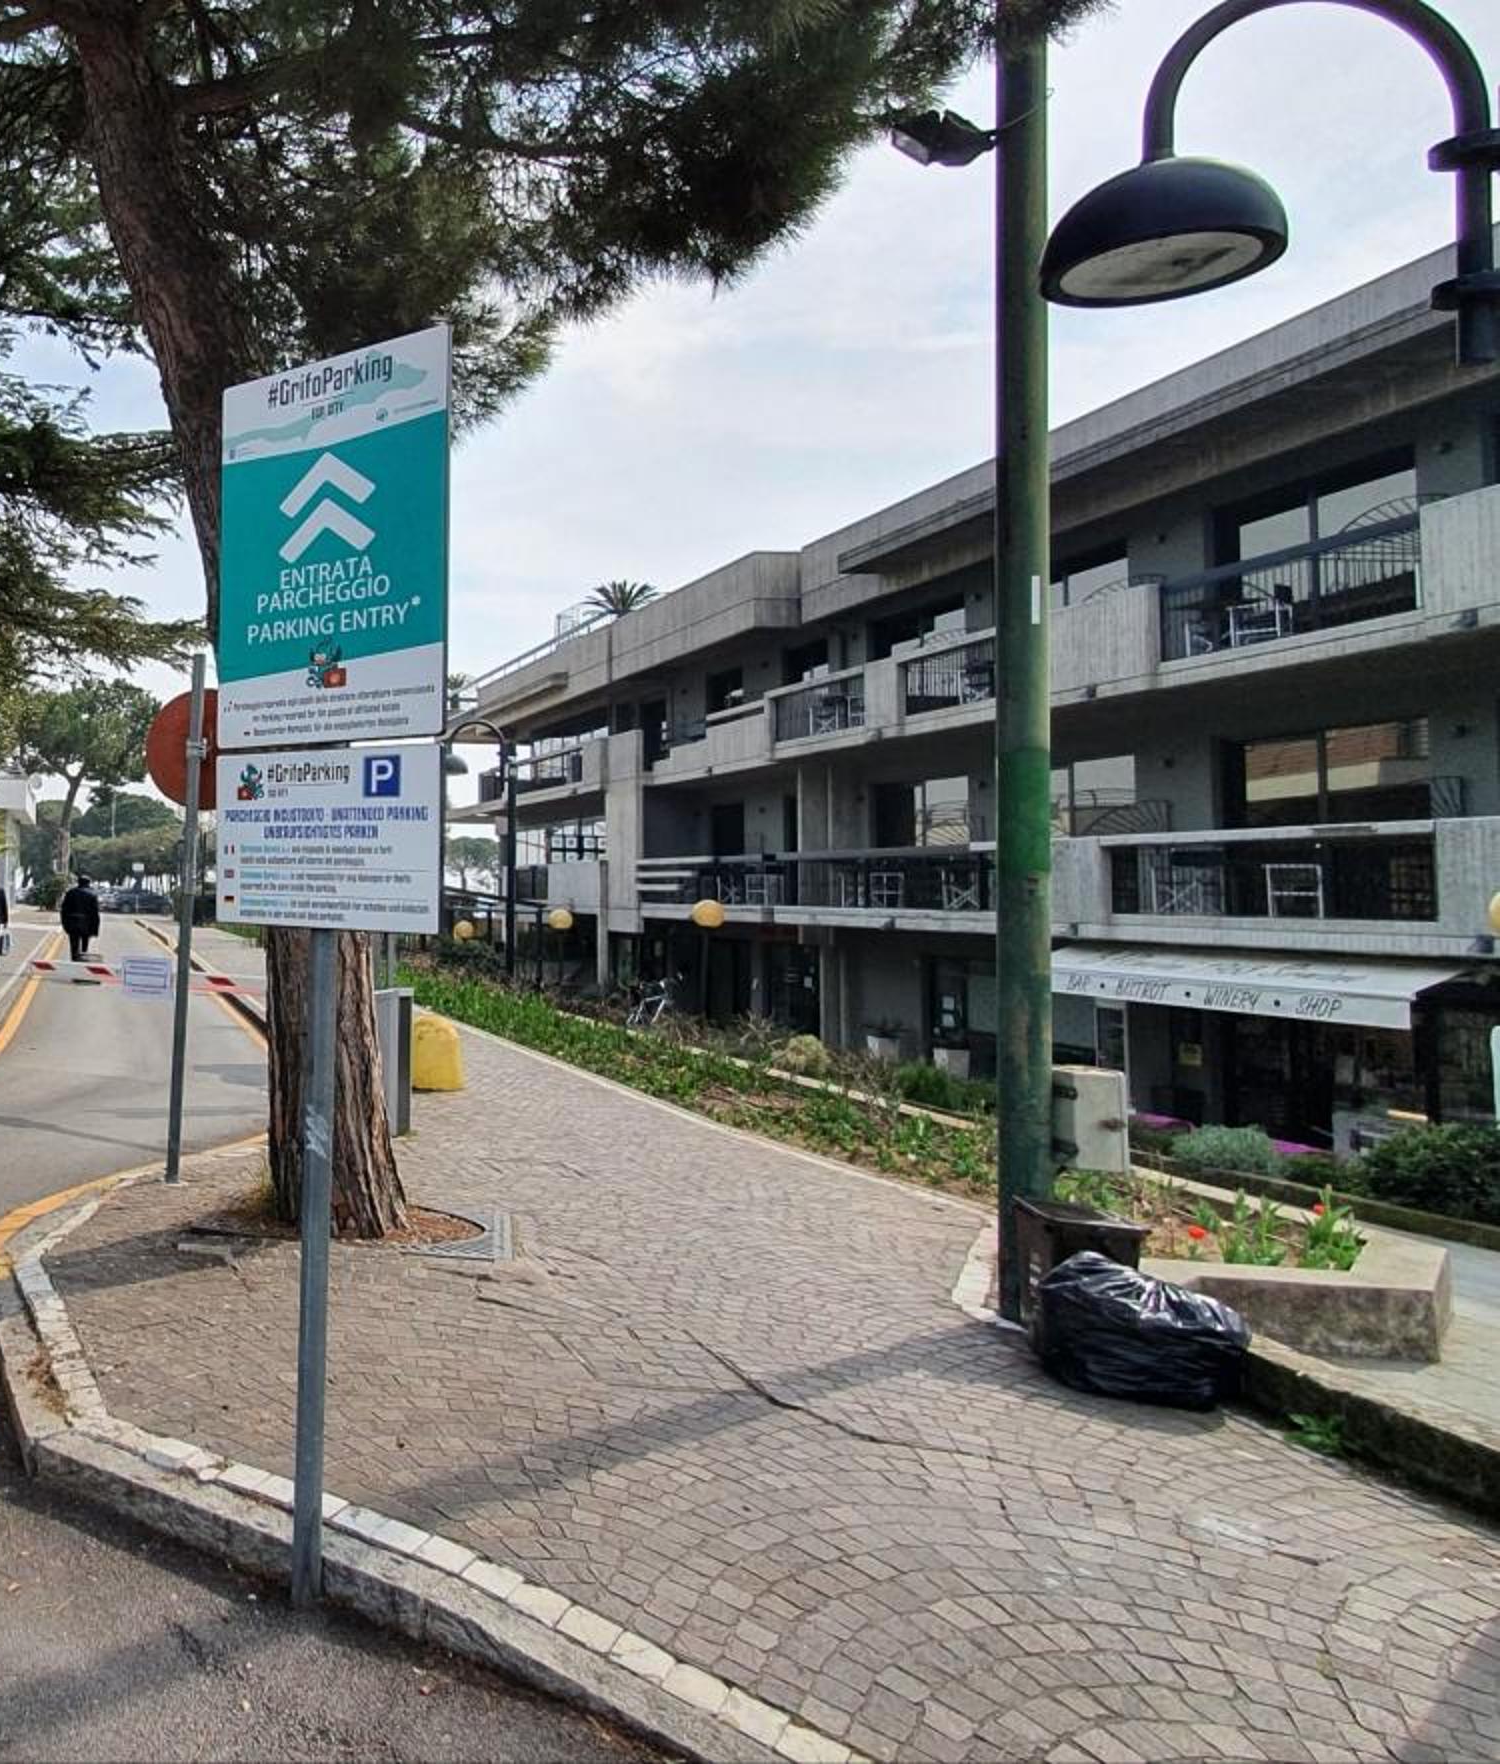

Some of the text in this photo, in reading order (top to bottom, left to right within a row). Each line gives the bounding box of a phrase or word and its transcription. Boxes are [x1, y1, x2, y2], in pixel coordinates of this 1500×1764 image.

[268, 355, 393, 408] #GrifoParking
[280, 556, 373, 590] ENTRATA
[257, 575, 390, 614] PARCHEGGIO
[247, 614, 335, 645] PARKING
[267, 762, 351, 784] #GrifoParking
[371, 759, 393, 793] P
[387, 805, 428, 821] PARKING
[1066, 974, 1091, 992] BAR
[1203, 986, 1261, 1010] WINERY
[1295, 994, 1342, 1018] SHOP
